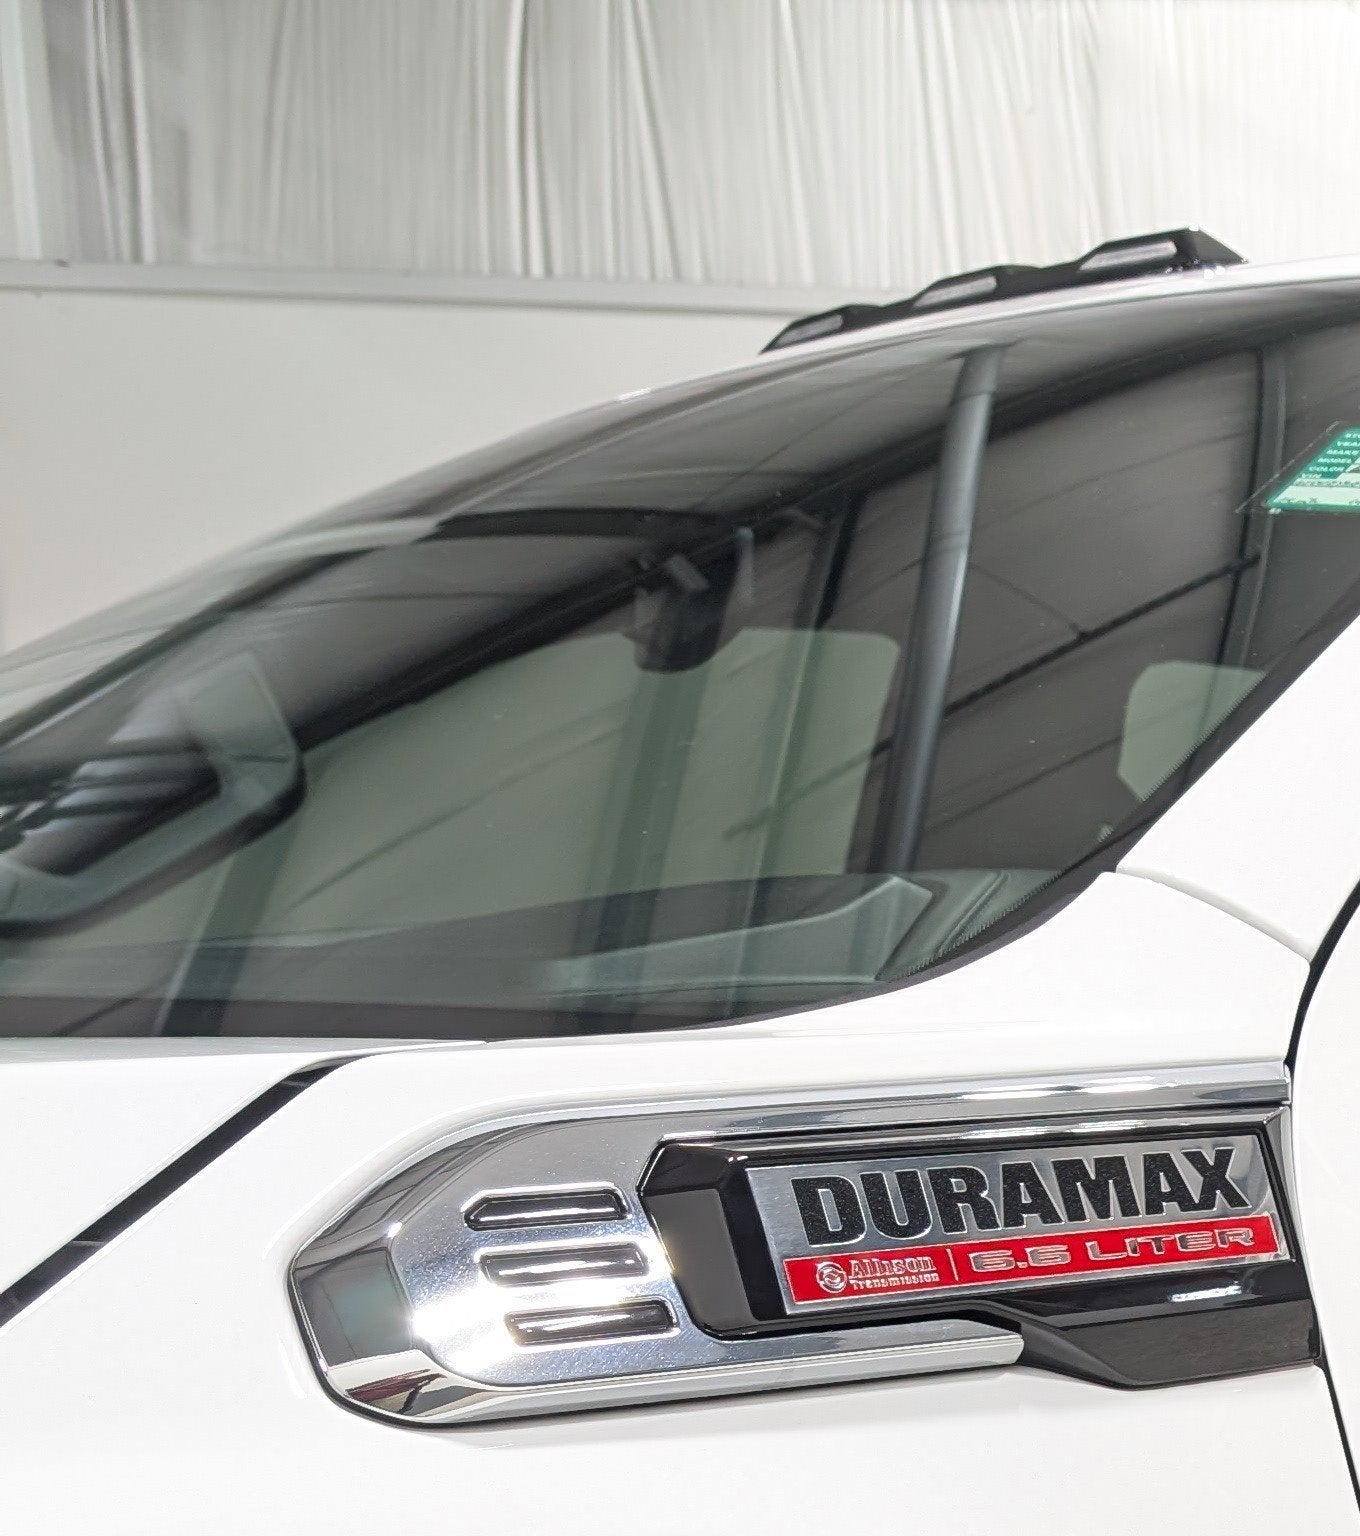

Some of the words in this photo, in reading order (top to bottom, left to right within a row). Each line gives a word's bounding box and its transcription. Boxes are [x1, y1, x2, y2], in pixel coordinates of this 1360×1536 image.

[790, 1146, 1253, 1249] DURAMAX
[968, 1245, 1072, 1273] 6.6
[1084, 1227, 1255, 1261] LITER
[848, 1256, 937, 1279] Allison
[848, 1272, 941, 1291] Transmission
